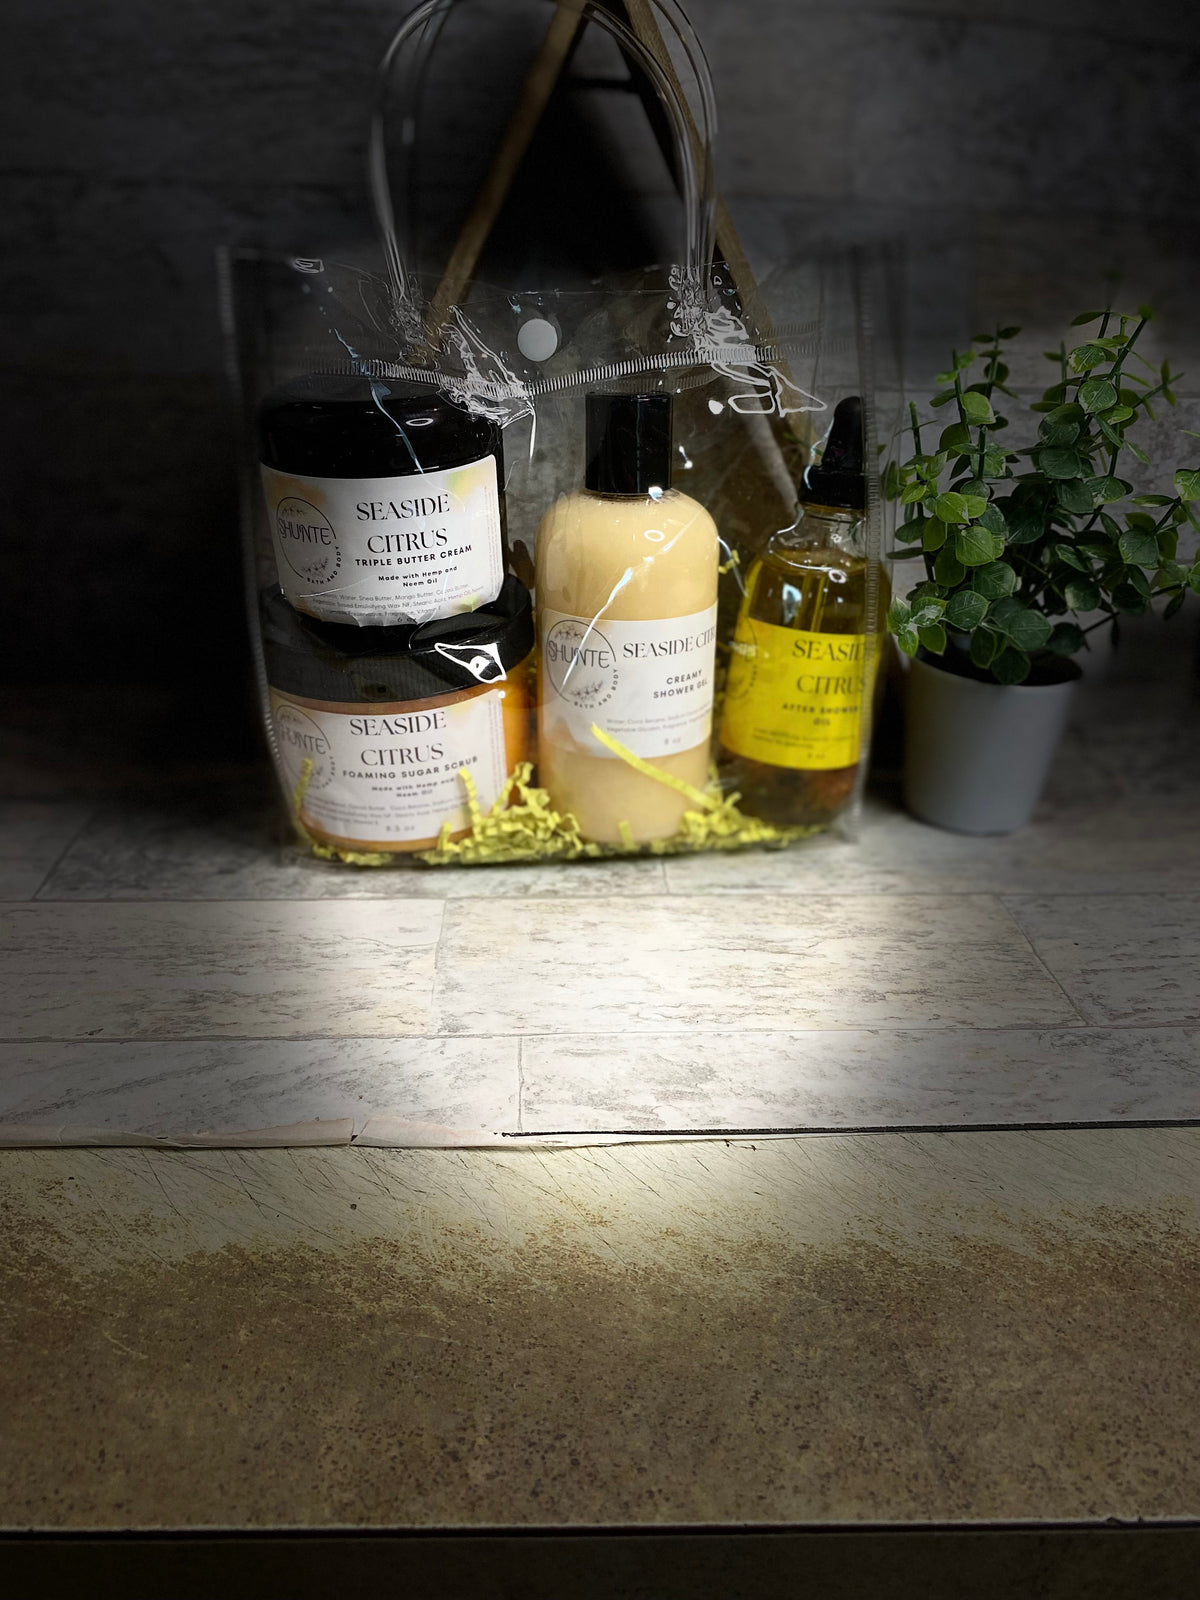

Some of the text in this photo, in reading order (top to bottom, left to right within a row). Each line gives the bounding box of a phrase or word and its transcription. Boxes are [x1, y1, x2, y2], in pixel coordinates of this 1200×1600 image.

[356, 493, 450, 521] SEASIDE
[367, 527, 448, 554] CITRUS
[326, 570, 338, 583] AND
[334, 545, 342, 567] BODY
[355, 544, 473, 567] TRIPLE BUTTER CREAM
[402, 571, 420, 580] with
[422, 568, 443, 579] Hemp
[445, 565, 458, 575] and
[622, 636, 694, 658] SEASIDE
[598, 693, 612, 706] AND
[611, 668, 619, 691] BODY
[653, 678, 708, 699] SHOWER GEL
[666, 669, 702, 685] CREAMY
[350, 711, 447, 736] SEASIDE
[361, 743, 444, 766] CITRUS
[343, 756, 478, 780] FOAMING SUGAR SCRUB
